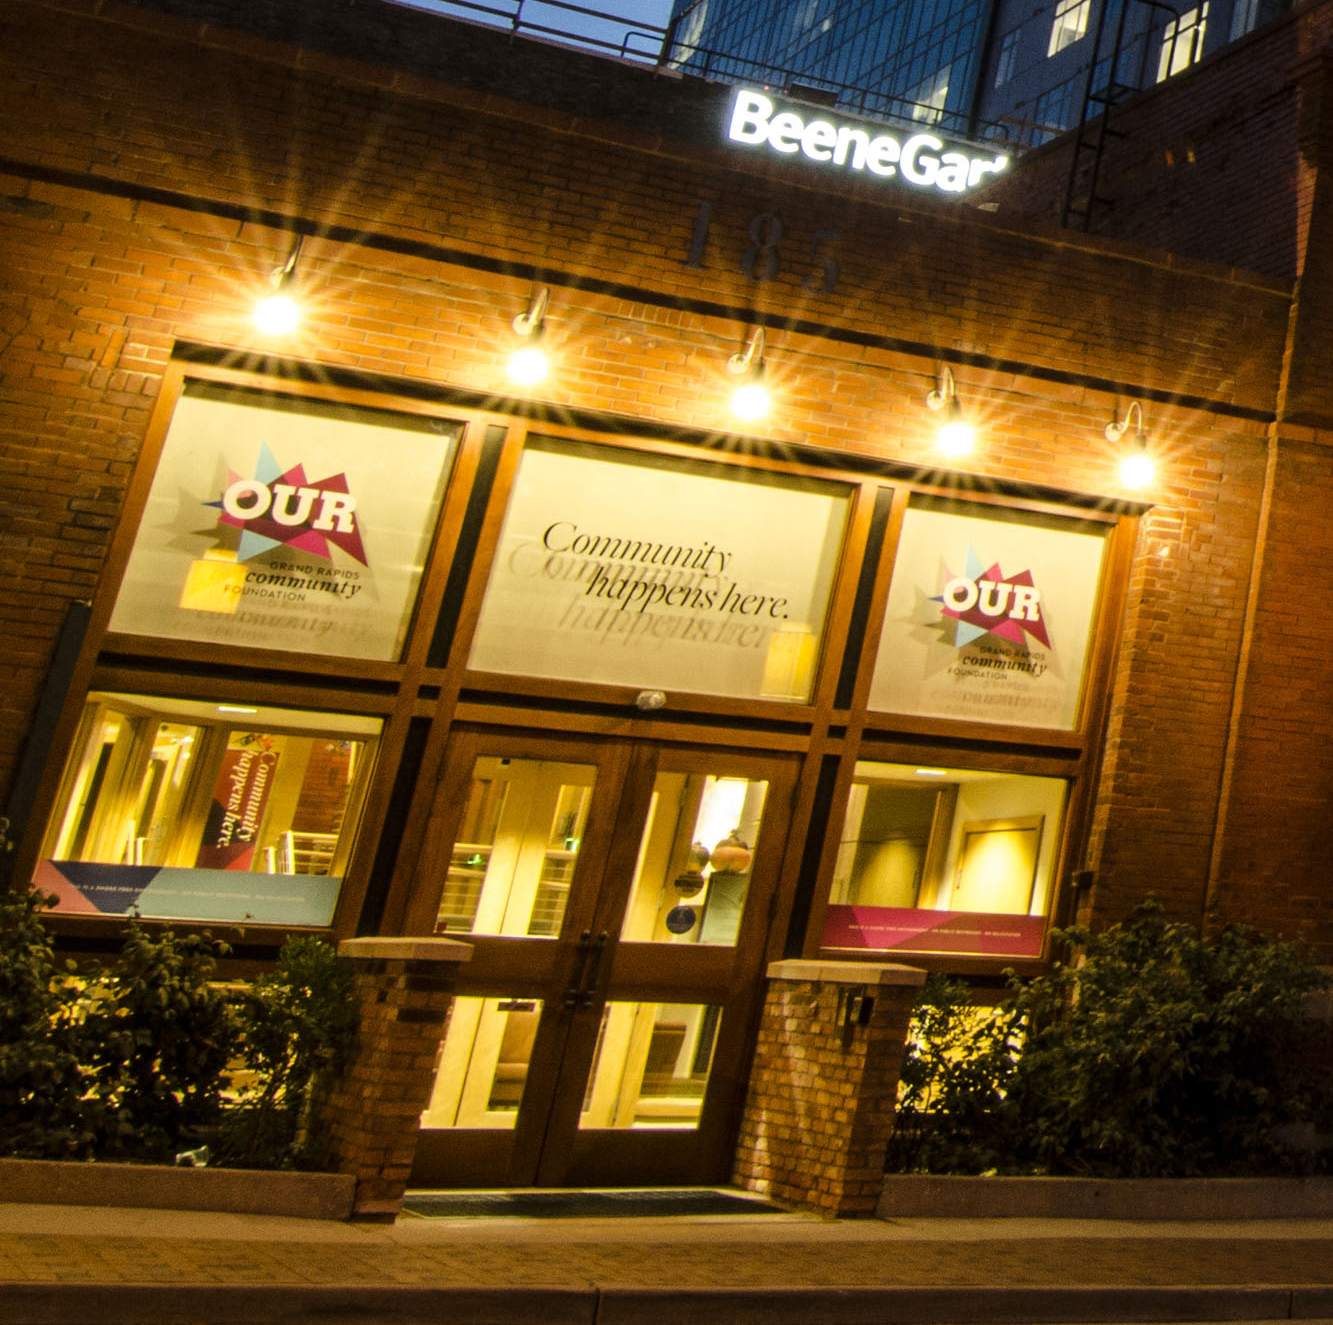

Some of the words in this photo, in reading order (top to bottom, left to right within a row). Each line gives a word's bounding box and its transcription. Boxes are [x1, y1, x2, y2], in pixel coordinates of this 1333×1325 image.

[677, 198, 842, 295] 185
[222, 479, 357, 534] OUR
[269, 560, 314, 575] GRAND
[316, 566, 361, 581] RAPIDS
[543, 521, 732, 578] Community
[223, 584, 307, 602] FOUNDATION
[245, 570, 362, 600] community
[585, 566, 717, 614] happens
[719, 582, 789, 620] here.
[942, 576, 1041, 622] OUR
[947, 667, 1008, 681] FOUNDATION
[962, 654, 1048, 678] community
[979, 645, 1012, 658] GRAND
[1014, 649, 1046, 661] RAPIDS
[228, 749, 260, 812] happens
[236, 751, 278, 842] Community
[216, 811, 242, 849] here.
